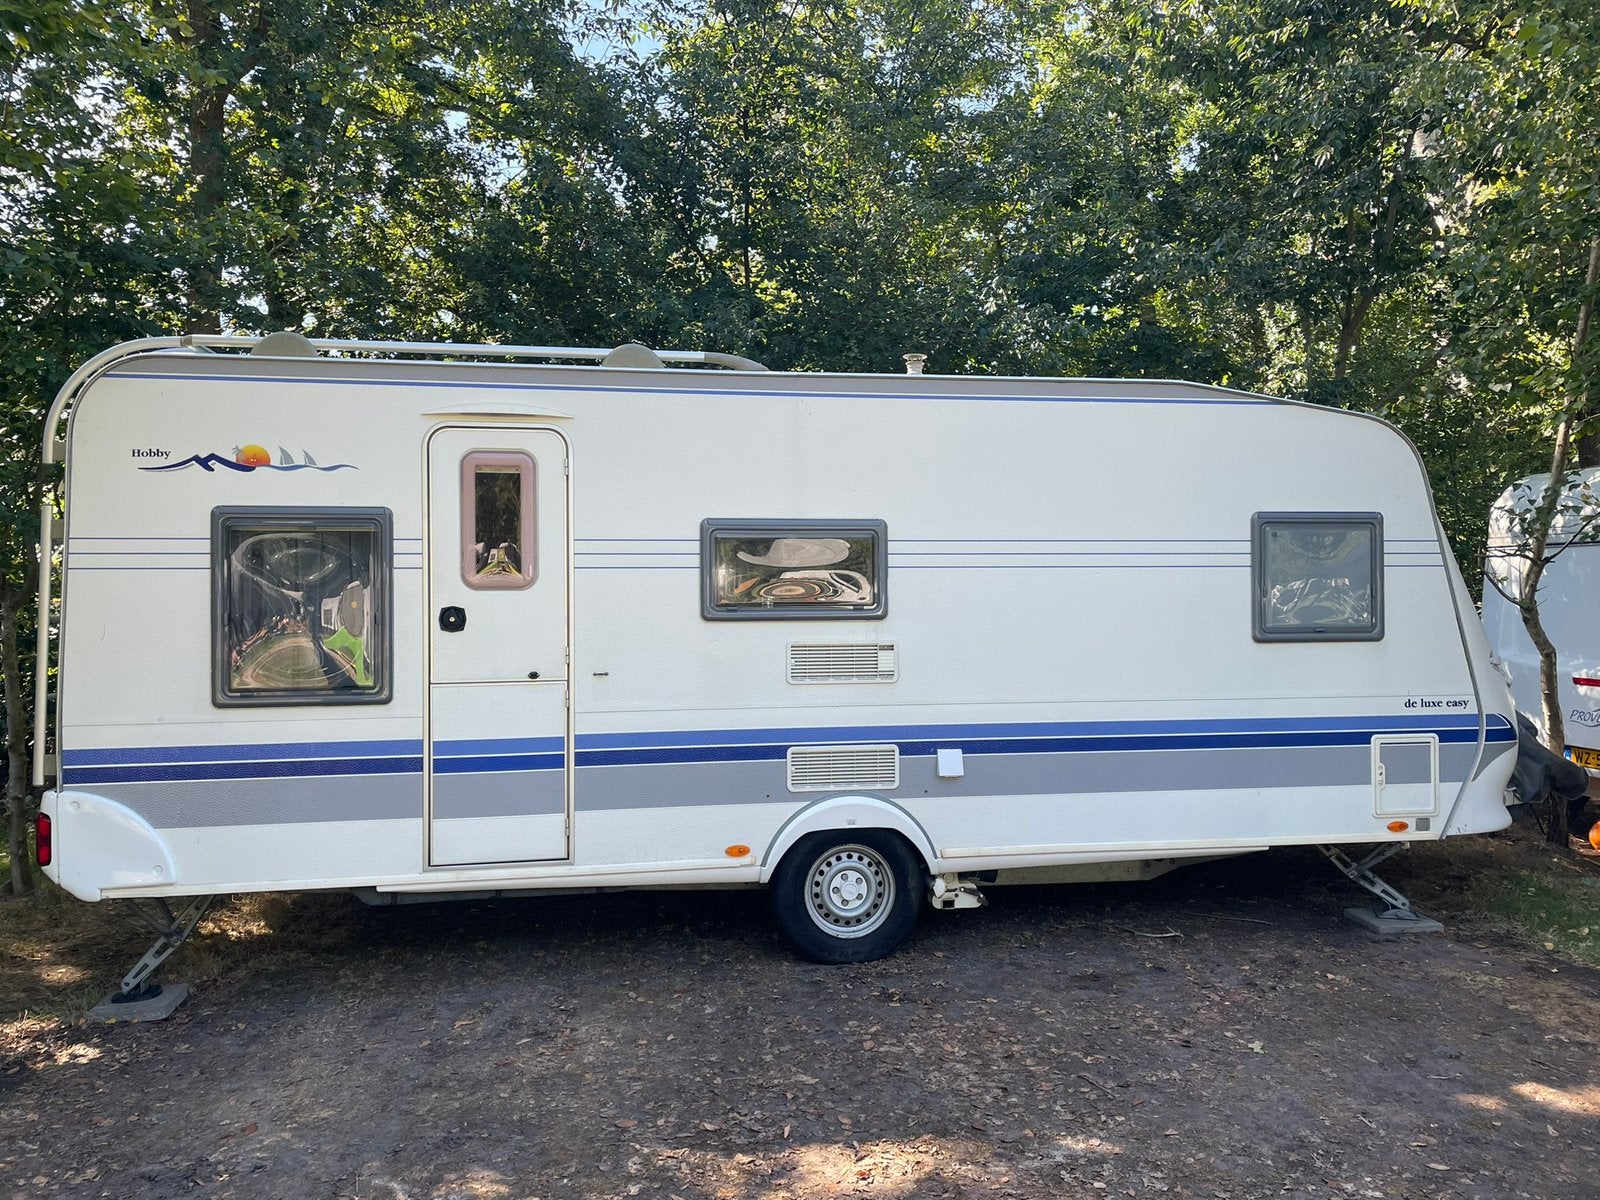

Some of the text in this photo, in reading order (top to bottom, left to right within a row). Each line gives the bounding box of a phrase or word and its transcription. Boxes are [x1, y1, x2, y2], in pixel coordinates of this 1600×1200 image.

[131, 448, 171, 460] Hobby
[1404, 698, 1470, 710] de luxe easy
